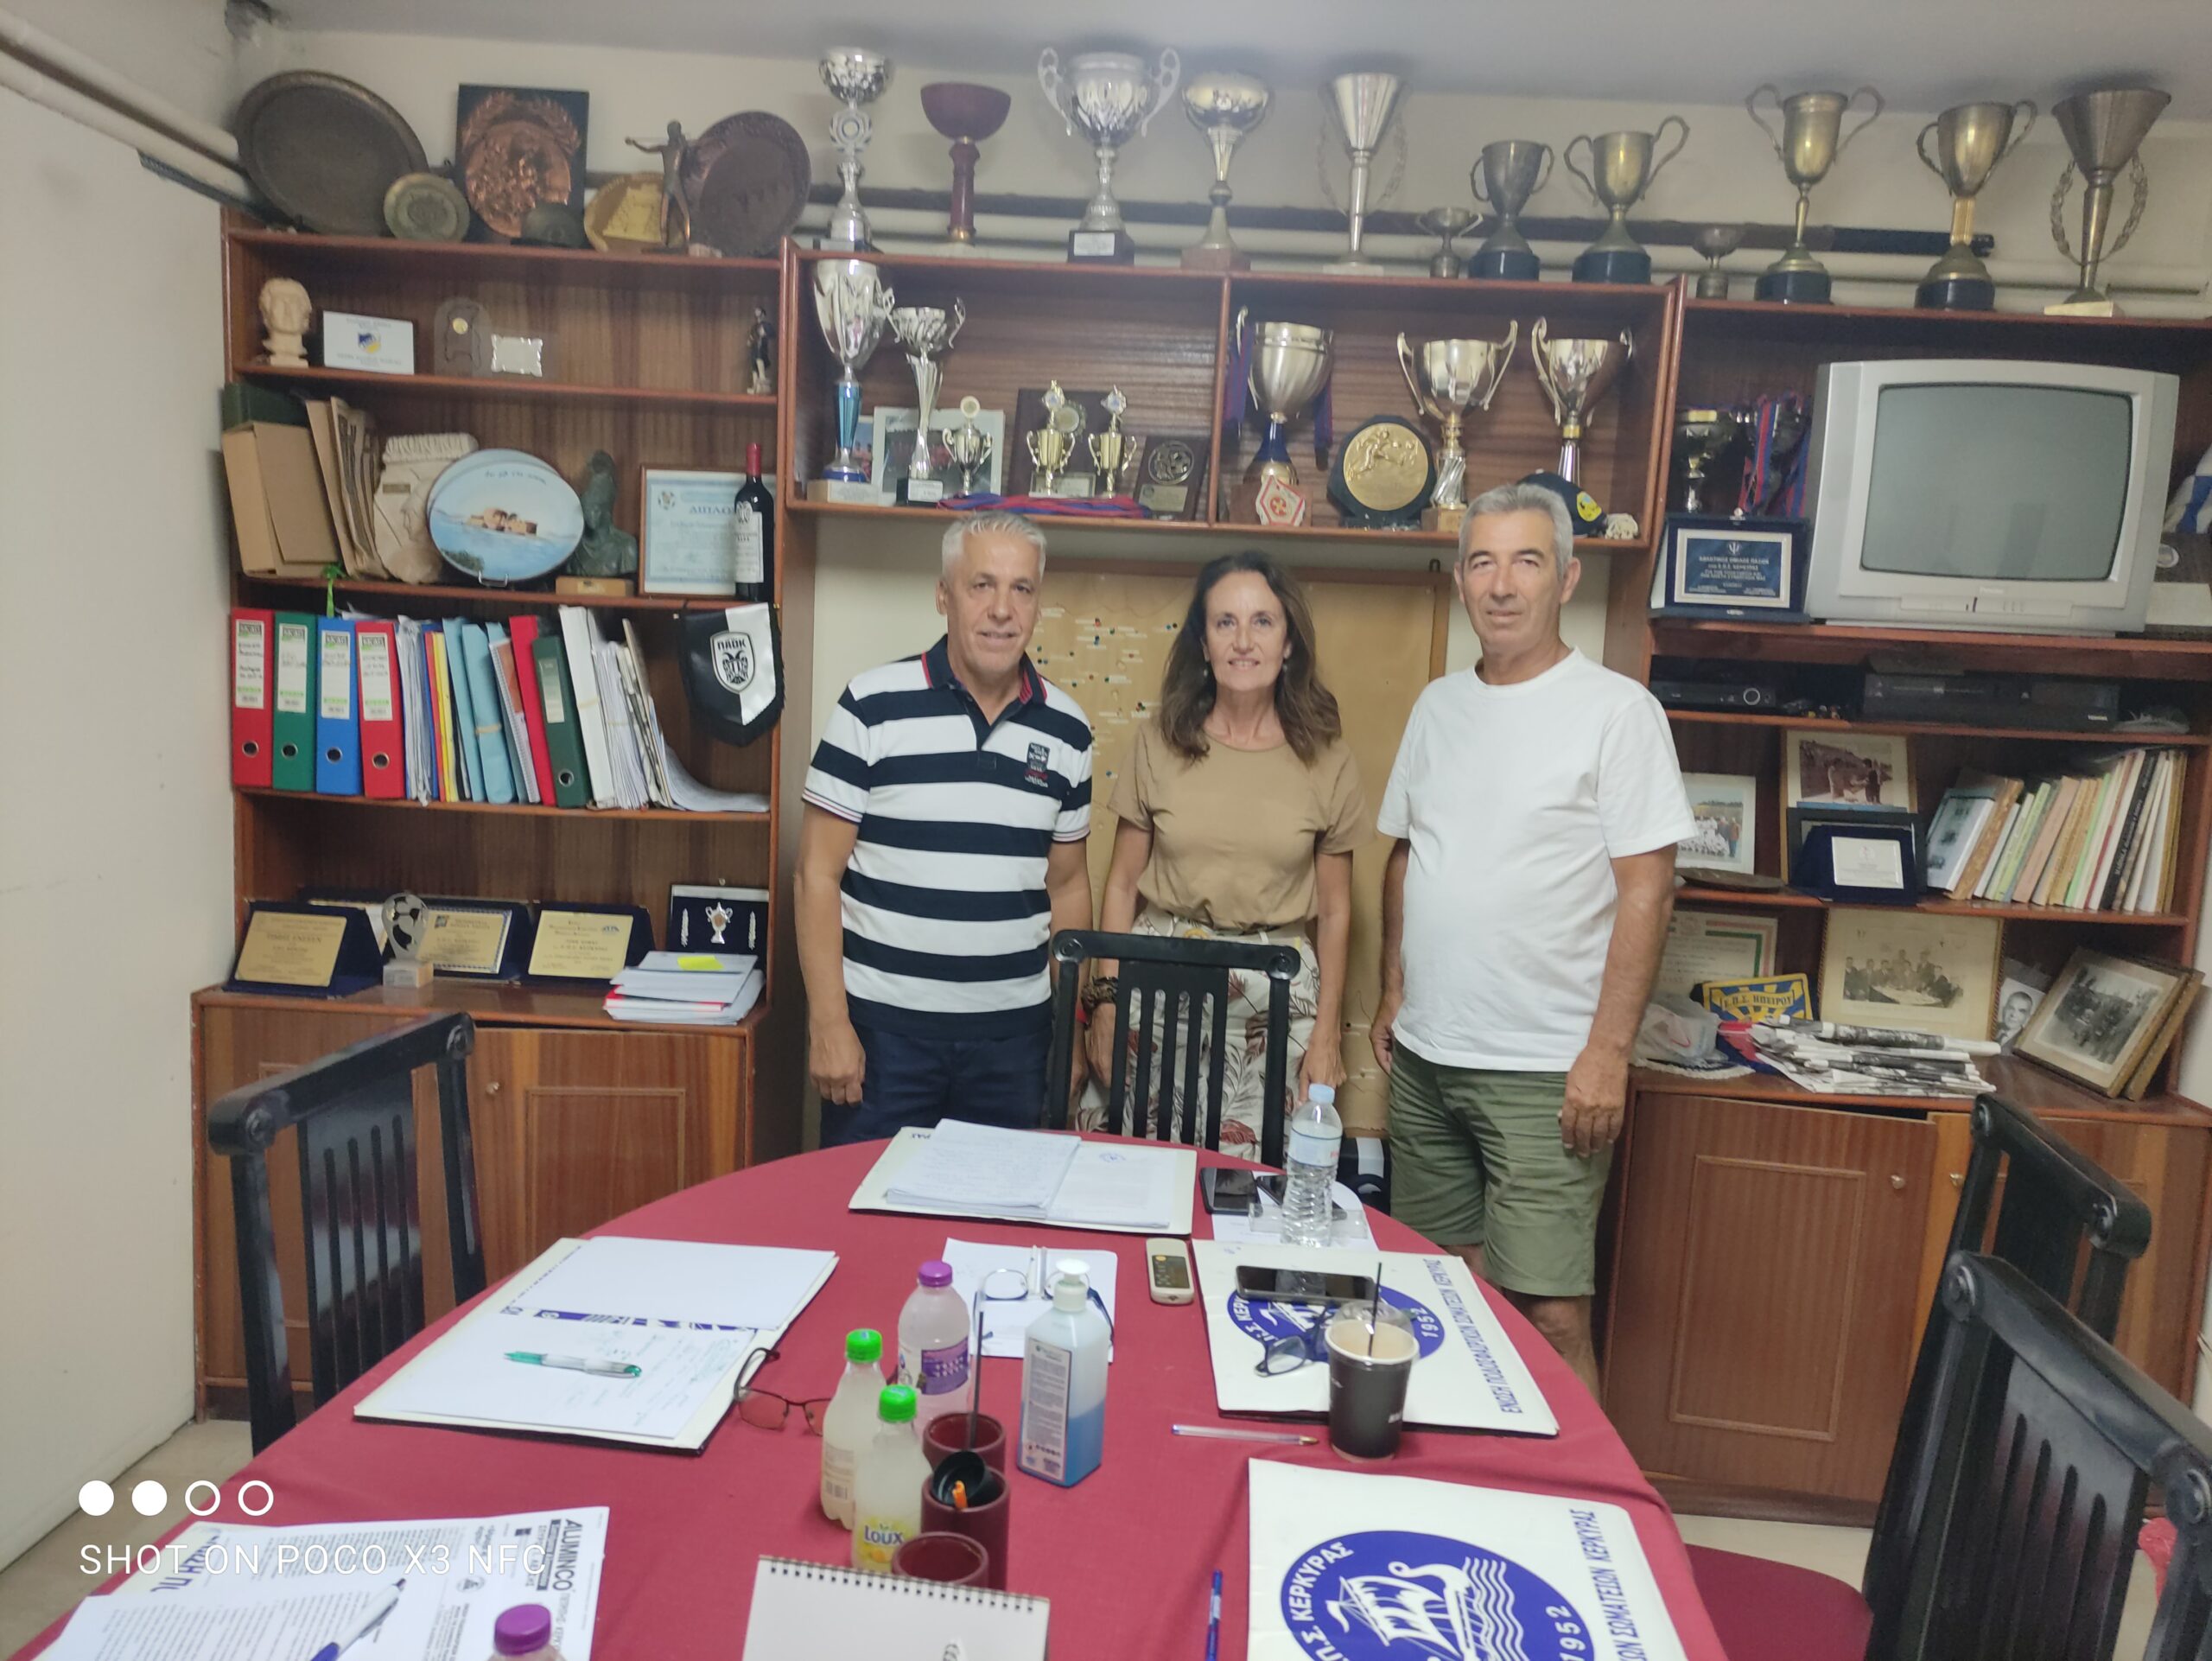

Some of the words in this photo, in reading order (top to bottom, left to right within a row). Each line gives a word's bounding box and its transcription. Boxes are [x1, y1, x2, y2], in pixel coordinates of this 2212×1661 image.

[1410, 1308, 1439, 1338] 1952
[551, 1518, 583, 1591] ALUMINCO
[1569, 1509, 1613, 1562] ΚΕΡΚΥΡΑΣ
[1288, 1541, 1355, 1622] ΚΕΡΚΥΡΑΣ
[1588, 1565, 1640, 1639] ΣΩΜΑΤΕΙΩΝ
